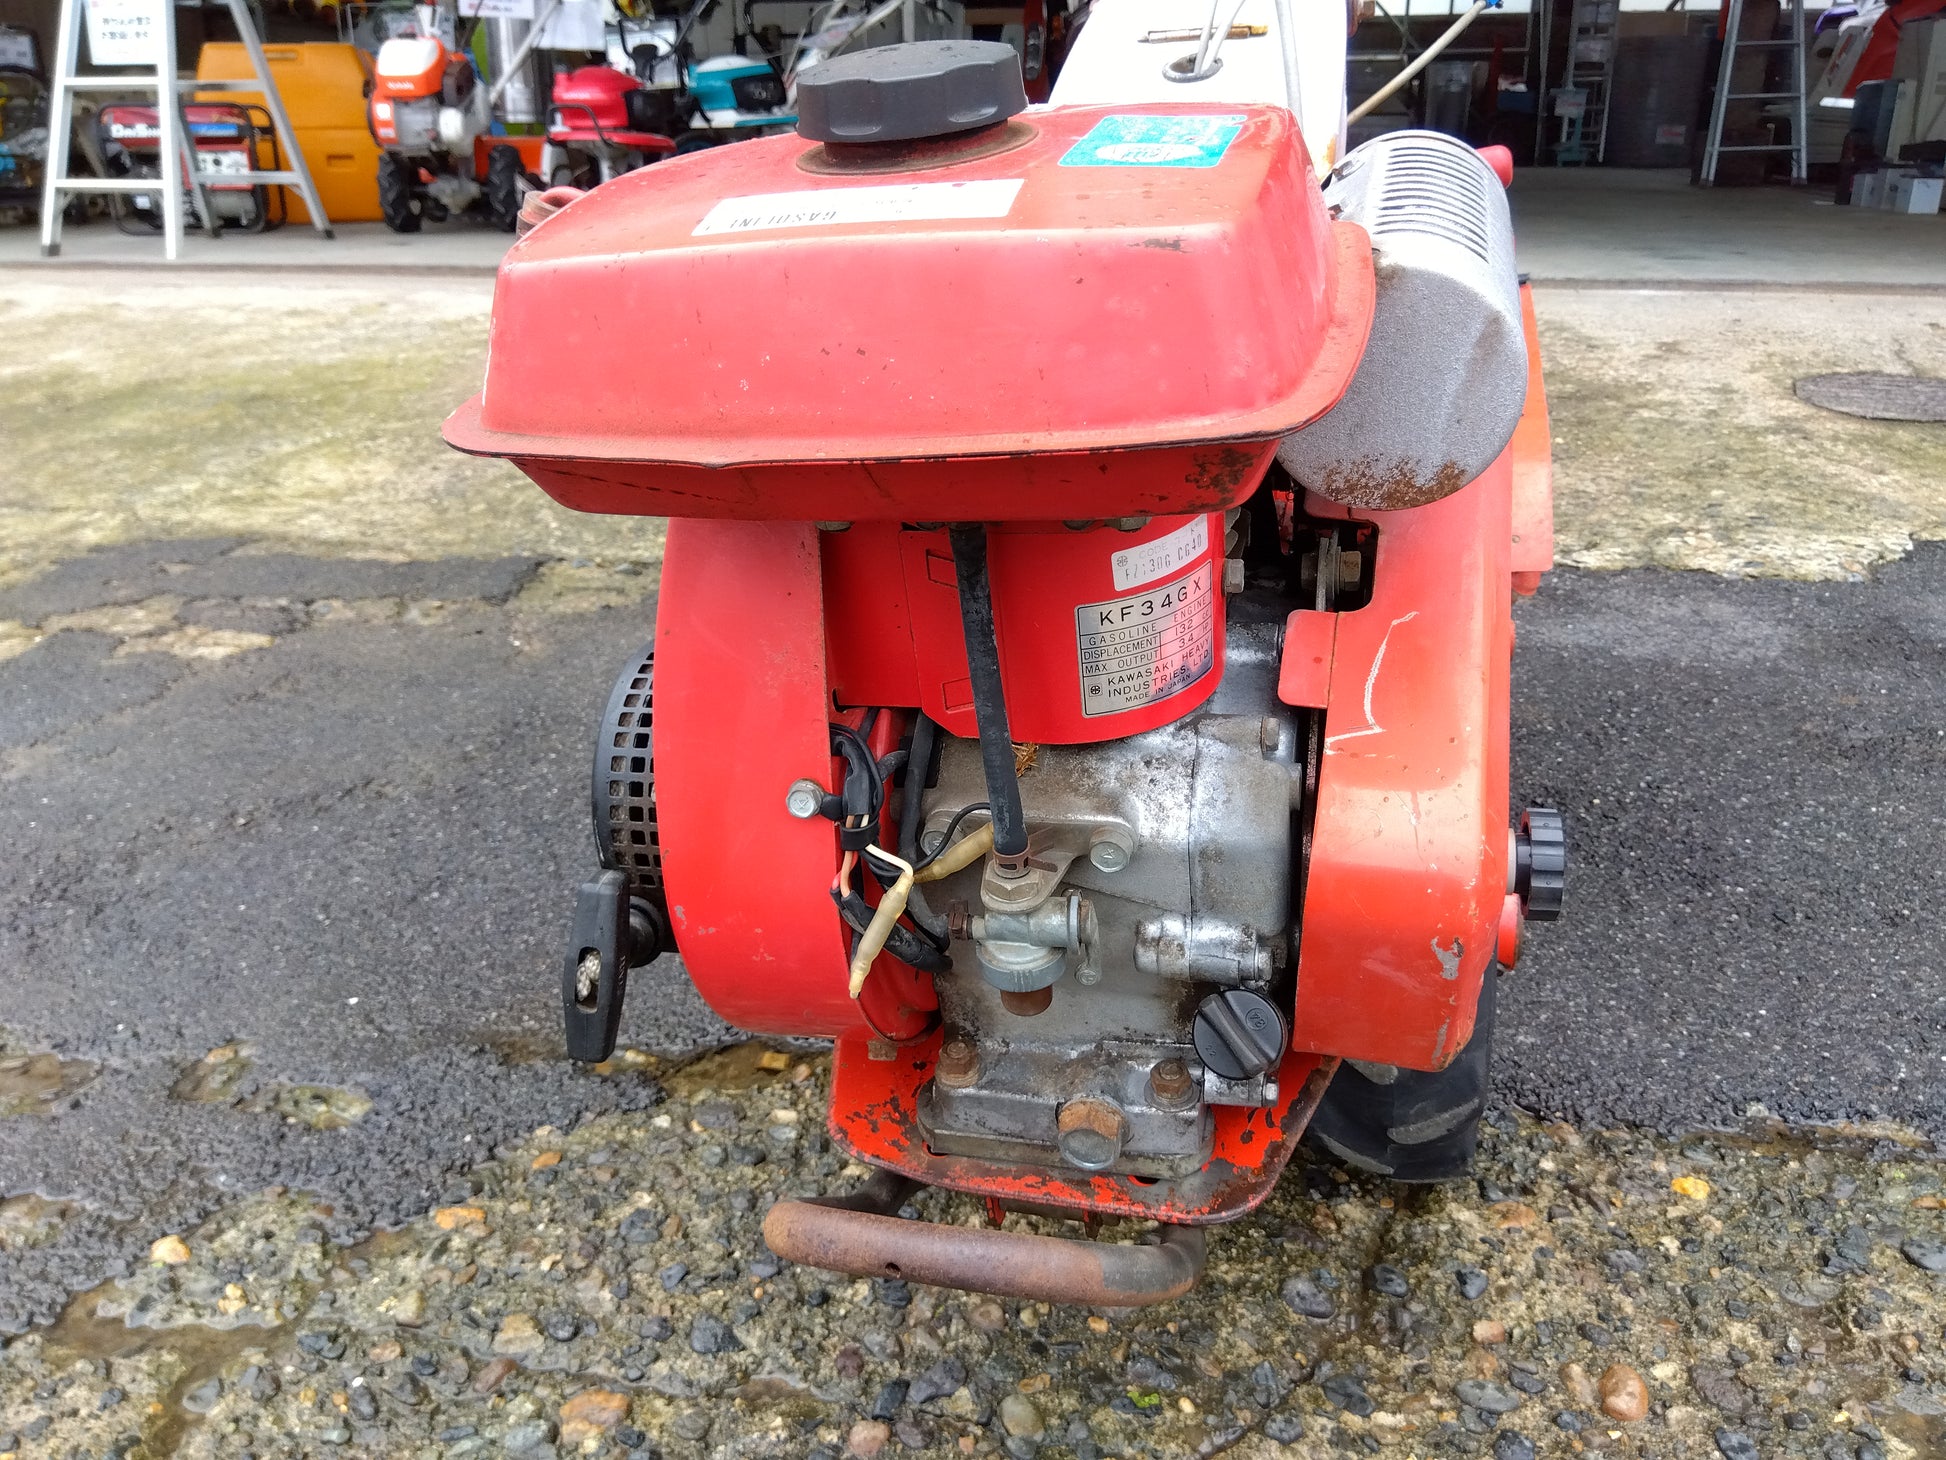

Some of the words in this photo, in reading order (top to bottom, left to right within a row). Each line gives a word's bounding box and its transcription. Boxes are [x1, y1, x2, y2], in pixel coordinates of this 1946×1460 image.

[1089, 622, 1157, 646] GASOLINE
[1174, 597, 1207, 622] ENGINE
[1100, 577, 1201, 626] KF34GX
[1084, 636, 1158, 660] DISPLACEMENT
[1176, 619, 1193, 636] 132
[1085, 664, 1108, 675] MAX
[1118, 650, 1159, 669] OUTPUT
[1179, 633, 1194, 649] 3.4
[1108, 660, 1173, 686] KAWASAKI
[1182, 638, 1210, 661] HEAVY
[1125, 691, 1150, 703] MADE
[1155, 686, 1164, 695] IN
[1168, 673, 1191, 690] JAPAN
